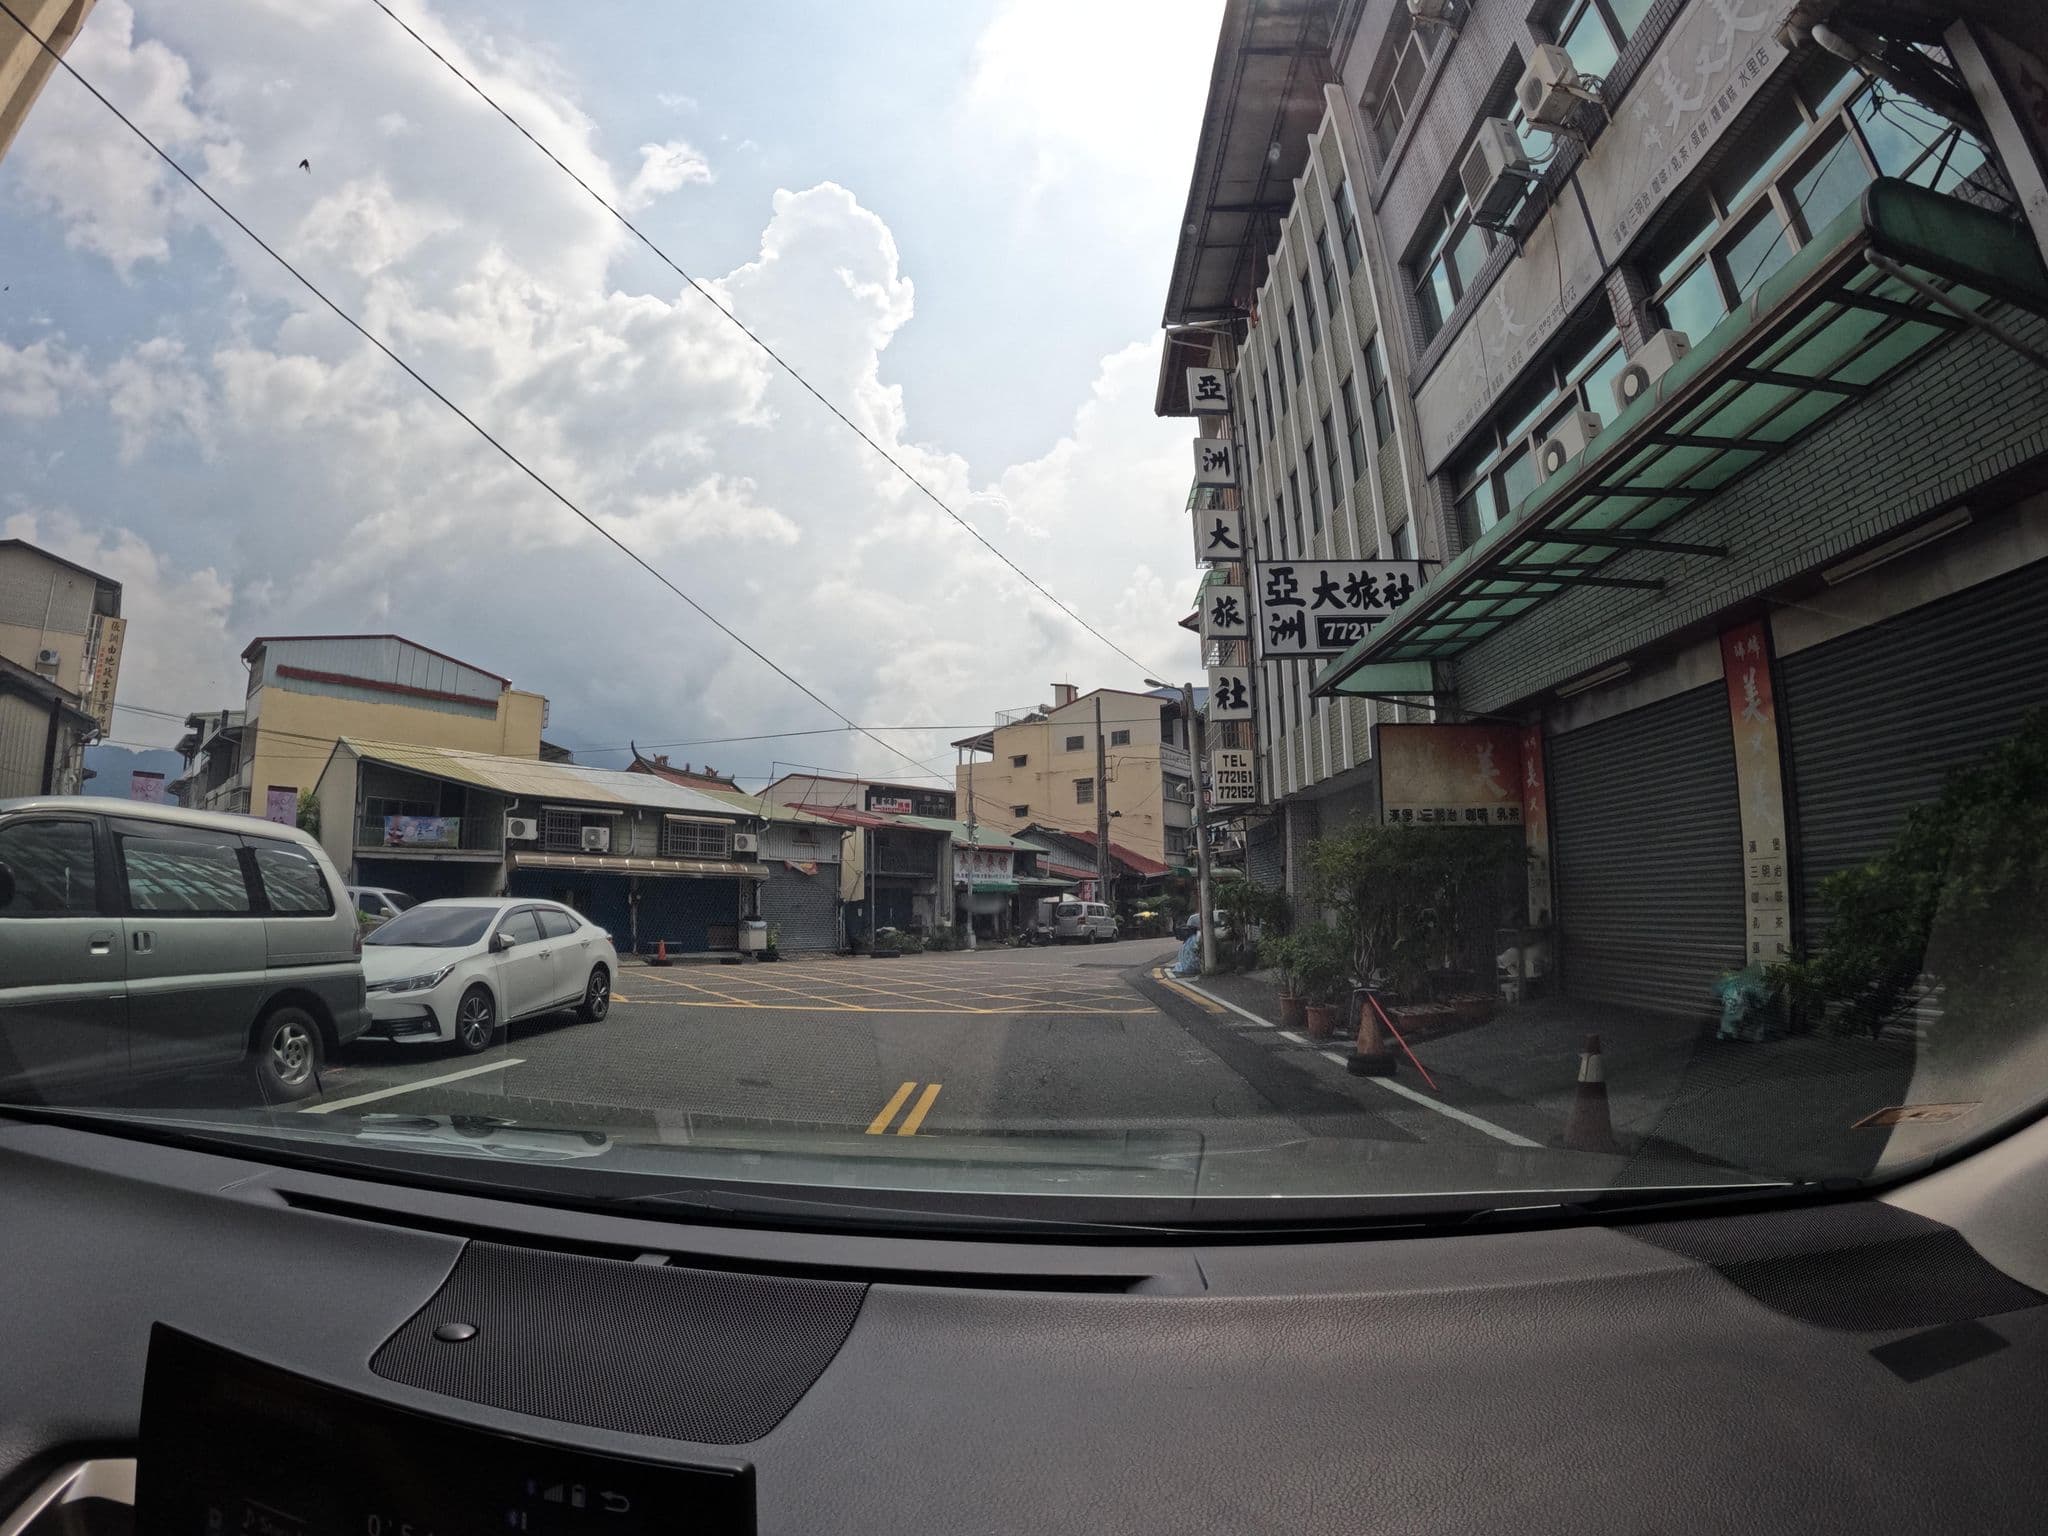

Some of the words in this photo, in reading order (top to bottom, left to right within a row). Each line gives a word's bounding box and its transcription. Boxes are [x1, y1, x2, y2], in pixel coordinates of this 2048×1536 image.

[1737, 46, 1770, 89] 水里店
[1323, 622, 1376, 640] 7721
[1222, 754, 1247, 767] TEL
[1217, 770, 1252, 784] 772151
[1218, 785, 1255, 799] 772152
